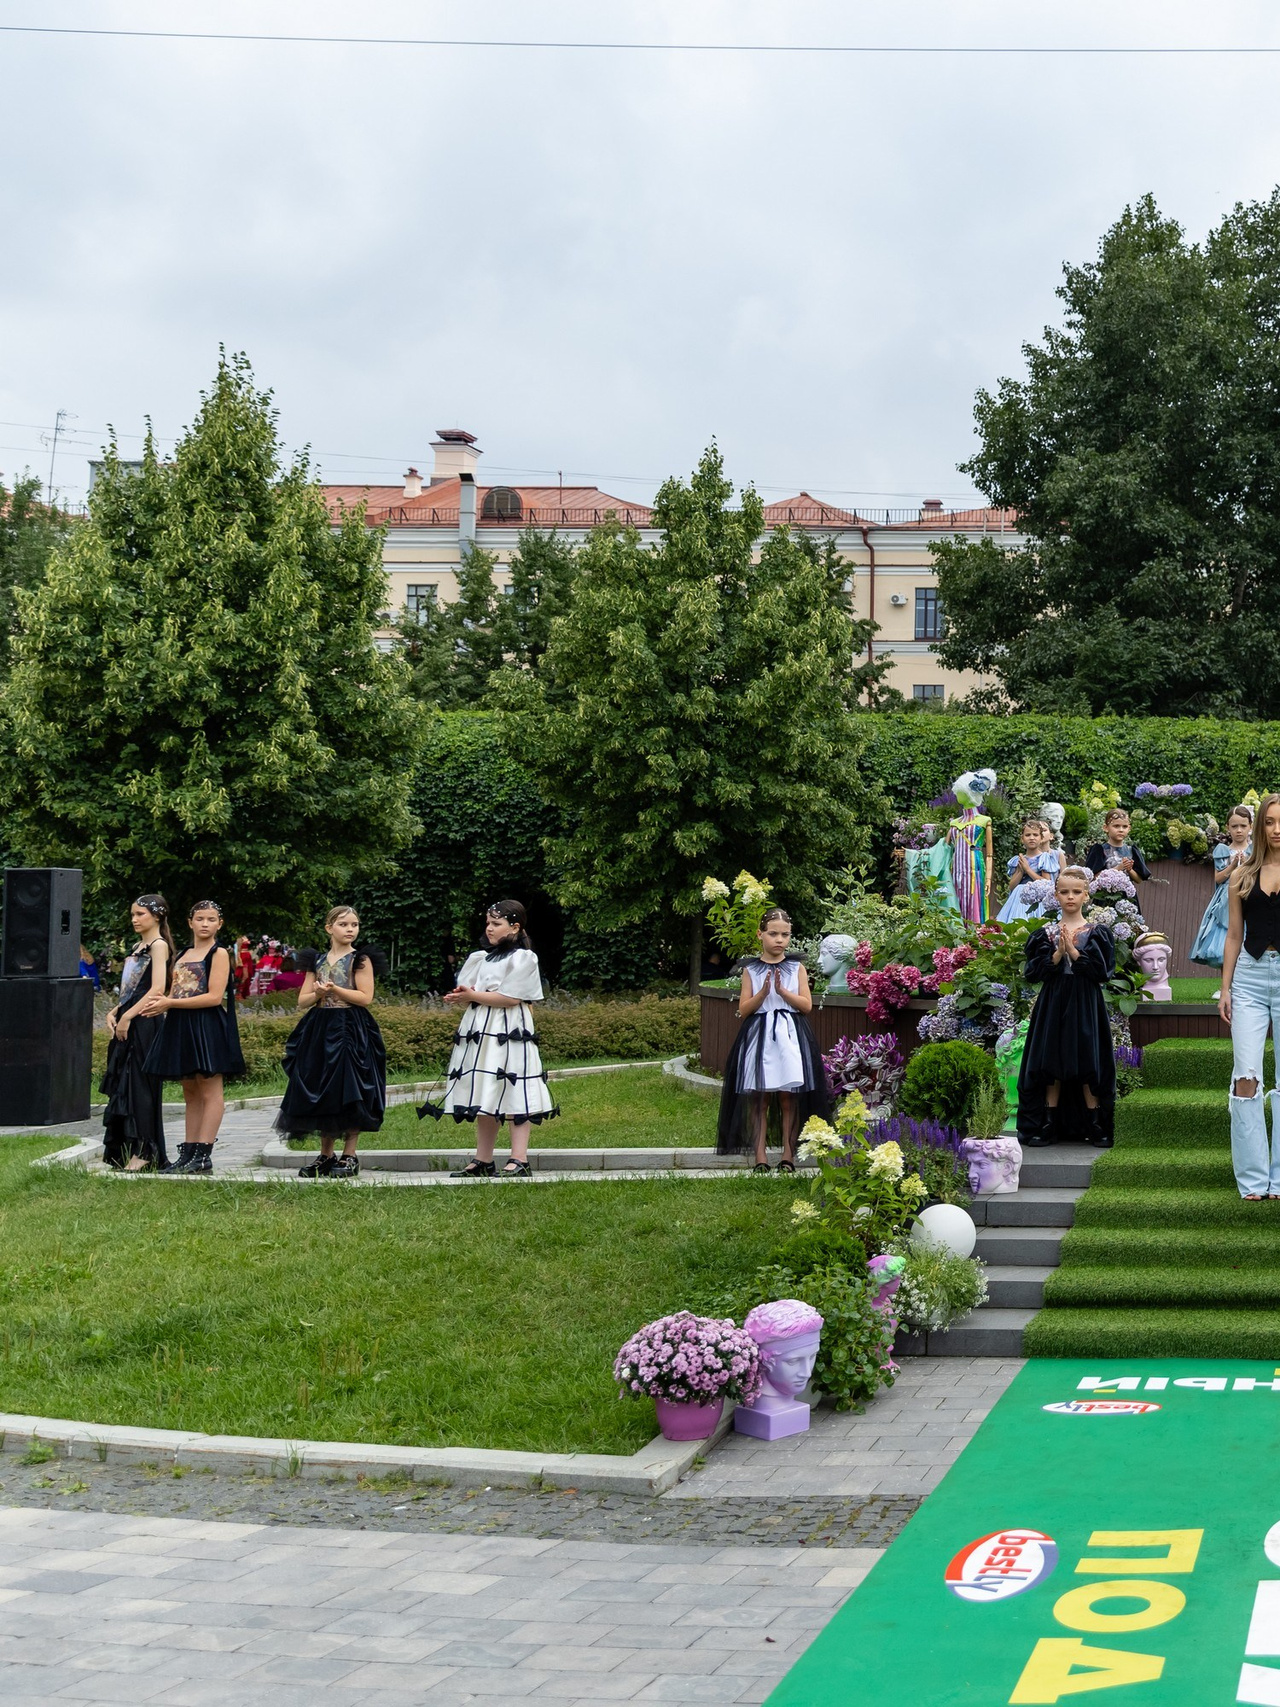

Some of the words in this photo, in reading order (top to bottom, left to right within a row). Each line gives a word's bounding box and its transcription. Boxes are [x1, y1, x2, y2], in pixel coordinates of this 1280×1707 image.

[1055, 1400, 1151, 1414] bestly
[950, 1534, 1055, 1594] bestly
[1007, 1528, 1205, 1704] ПОД
